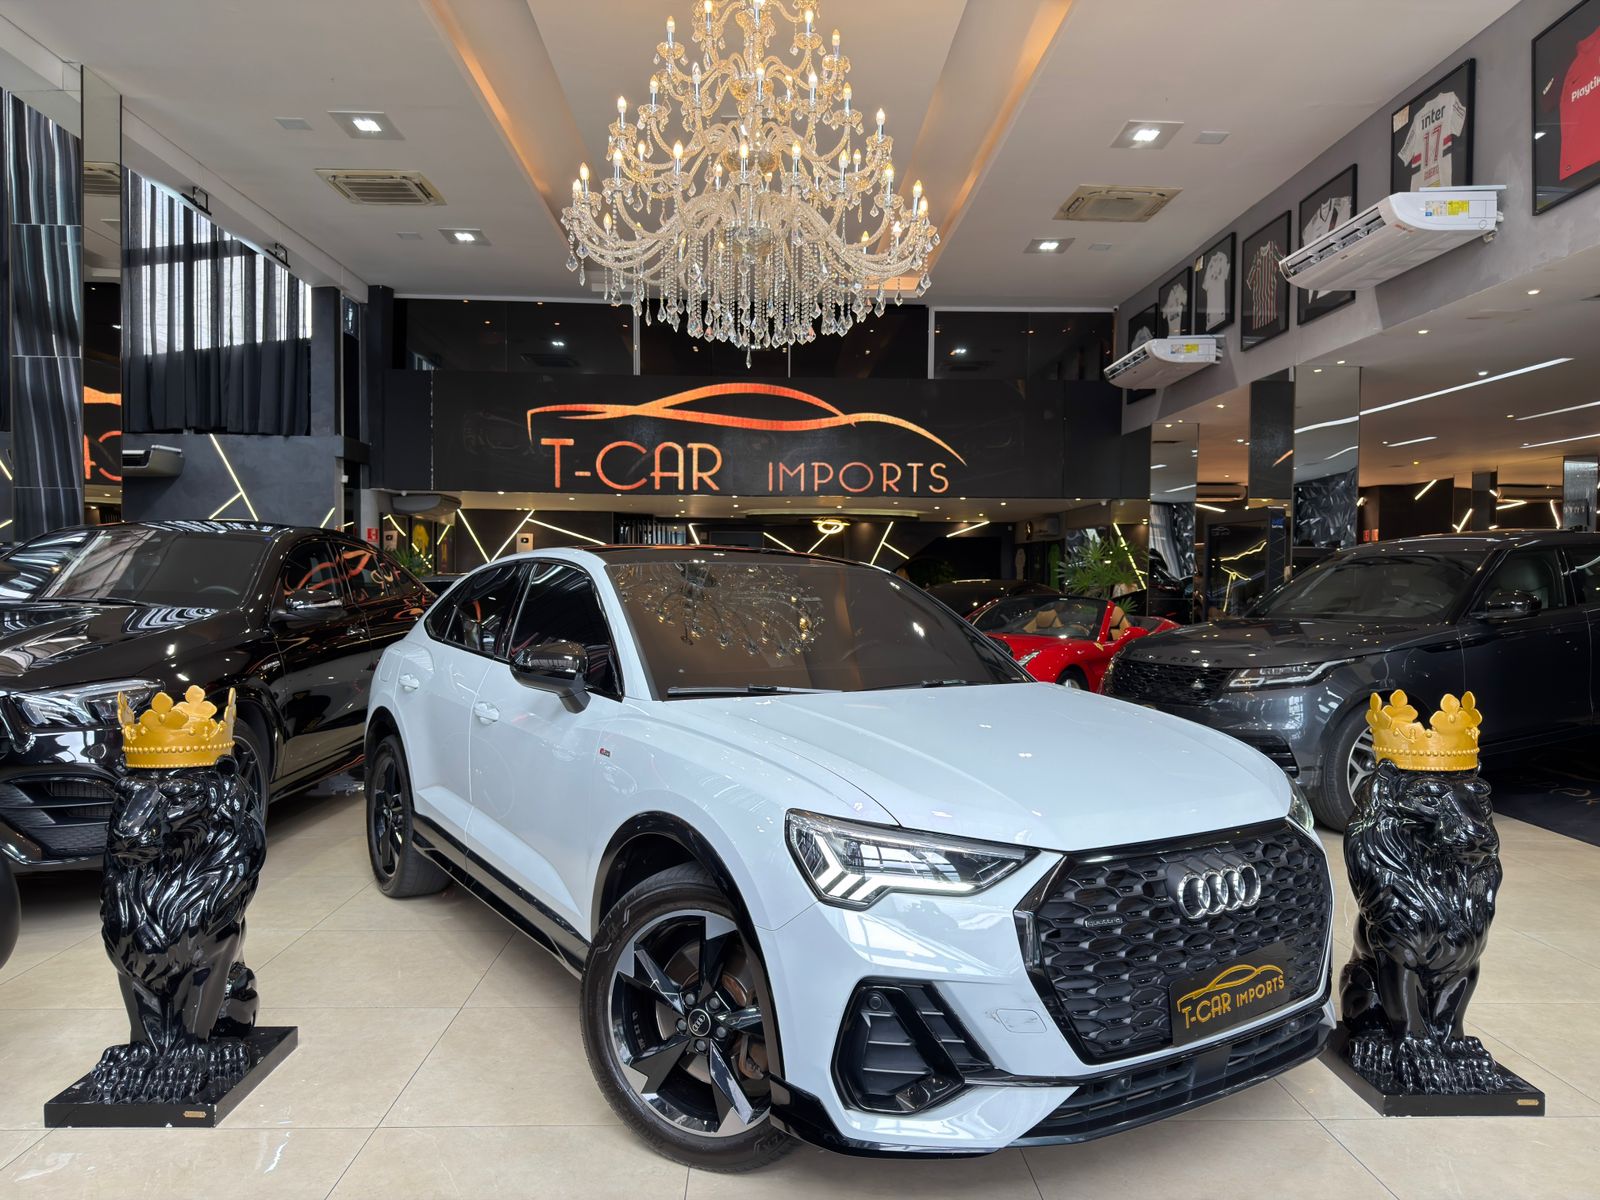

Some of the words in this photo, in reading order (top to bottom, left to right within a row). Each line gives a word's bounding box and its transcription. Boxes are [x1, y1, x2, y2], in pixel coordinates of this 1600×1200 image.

[1421, 105, 1446, 130] inter
[1423, 124, 1442, 167] 17
[540, 437, 722, 491] T-CAR
[768, 461, 949, 493] IMPORTS
[1181, 992, 1232, 1030] T-CAR
[1235, 974, 1285, 1008] IMPORTS
